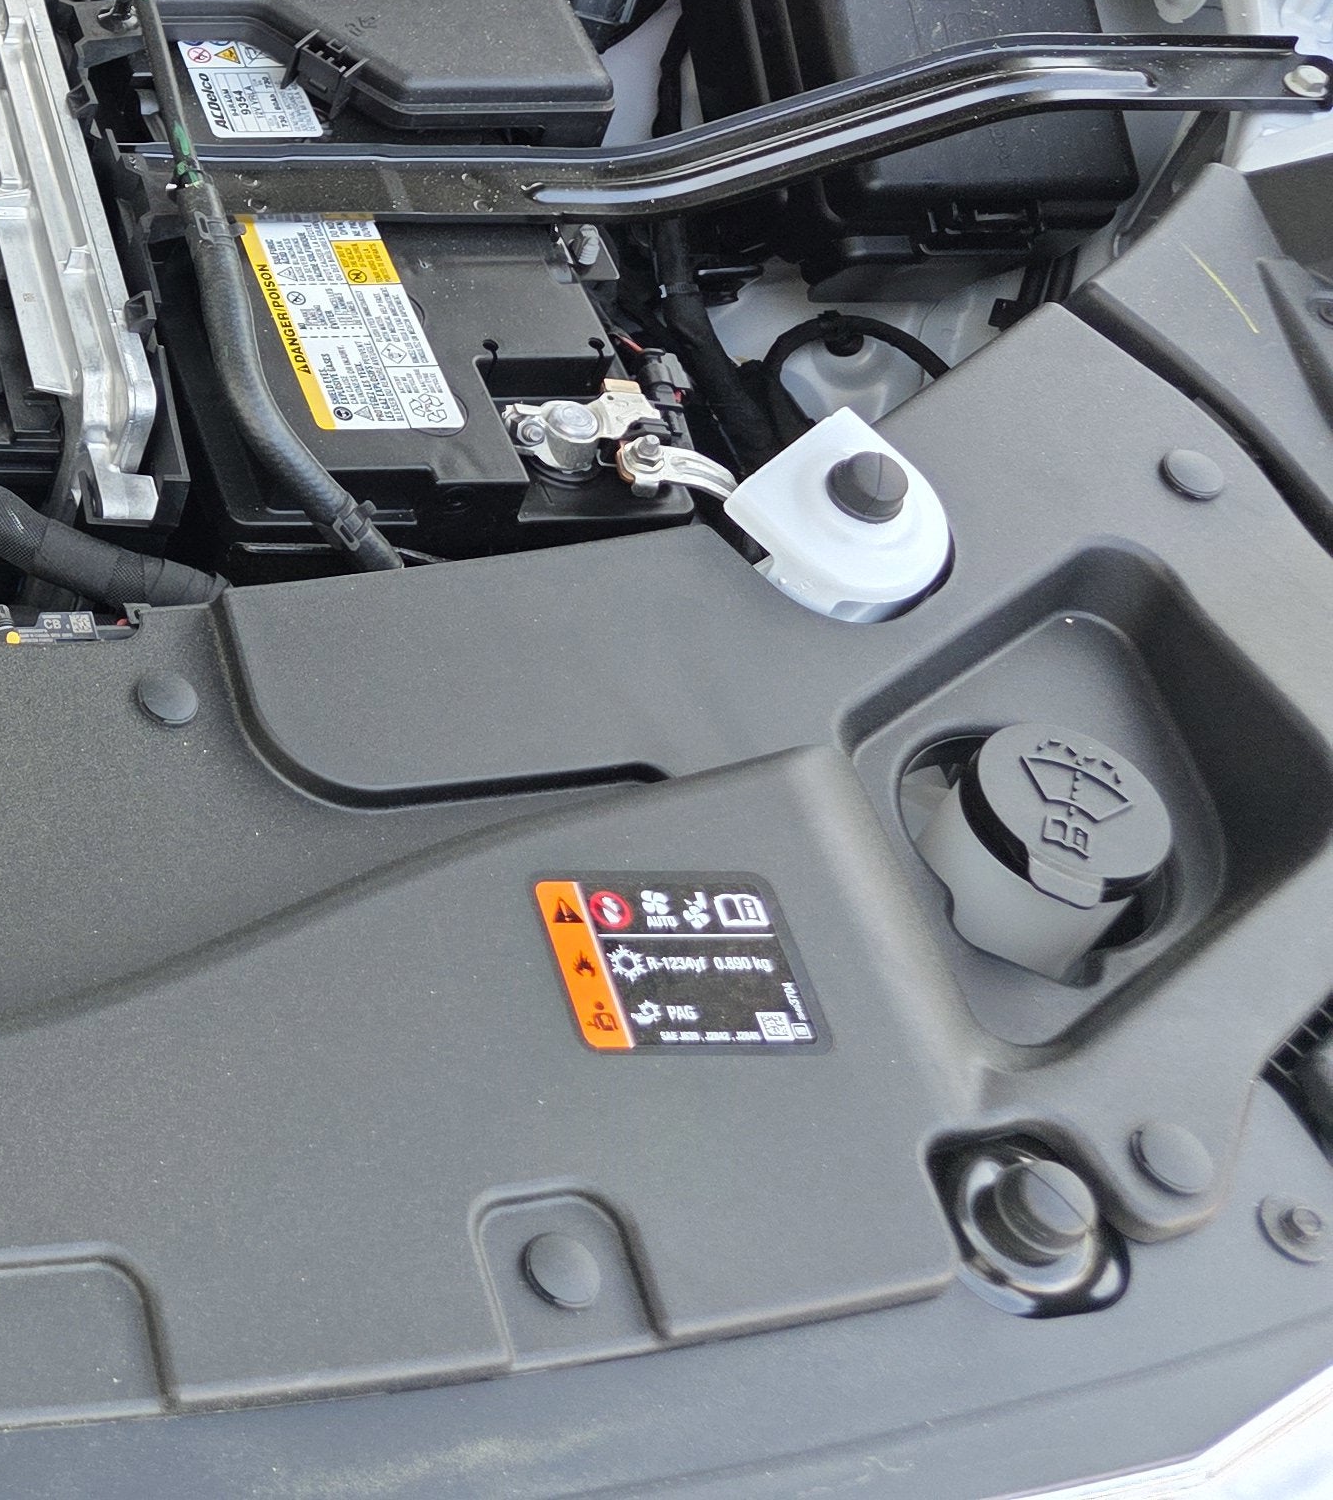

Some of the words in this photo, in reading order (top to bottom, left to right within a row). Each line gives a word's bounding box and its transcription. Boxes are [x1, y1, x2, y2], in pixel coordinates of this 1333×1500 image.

[199, 72, 229, 130] ACDelco
[232, 90, 251, 115] 9354
[279, 252, 290, 264] ACID
[256, 263, 307, 368] DANGER/POISON
[321, 353, 335, 371] GASES
[329, 374, 349, 404] EXPLOSIVE
[361, 380, 373, 390] LES
[325, 385, 340, 404] SHIELD
[348, 394, 359, 404] CAN
[378, 398, 390, 409] GAZ
[384, 411, 396, 421] LES
[43, 619, 62, 630] CB
[646, 915, 679, 928] AUTO
[645, 956, 708, 973] R-1234yf
[713, 956, 753, 970] 0.890
[752, 956, 775, 973] kg
[666, 1005, 701, 1021] PAG
